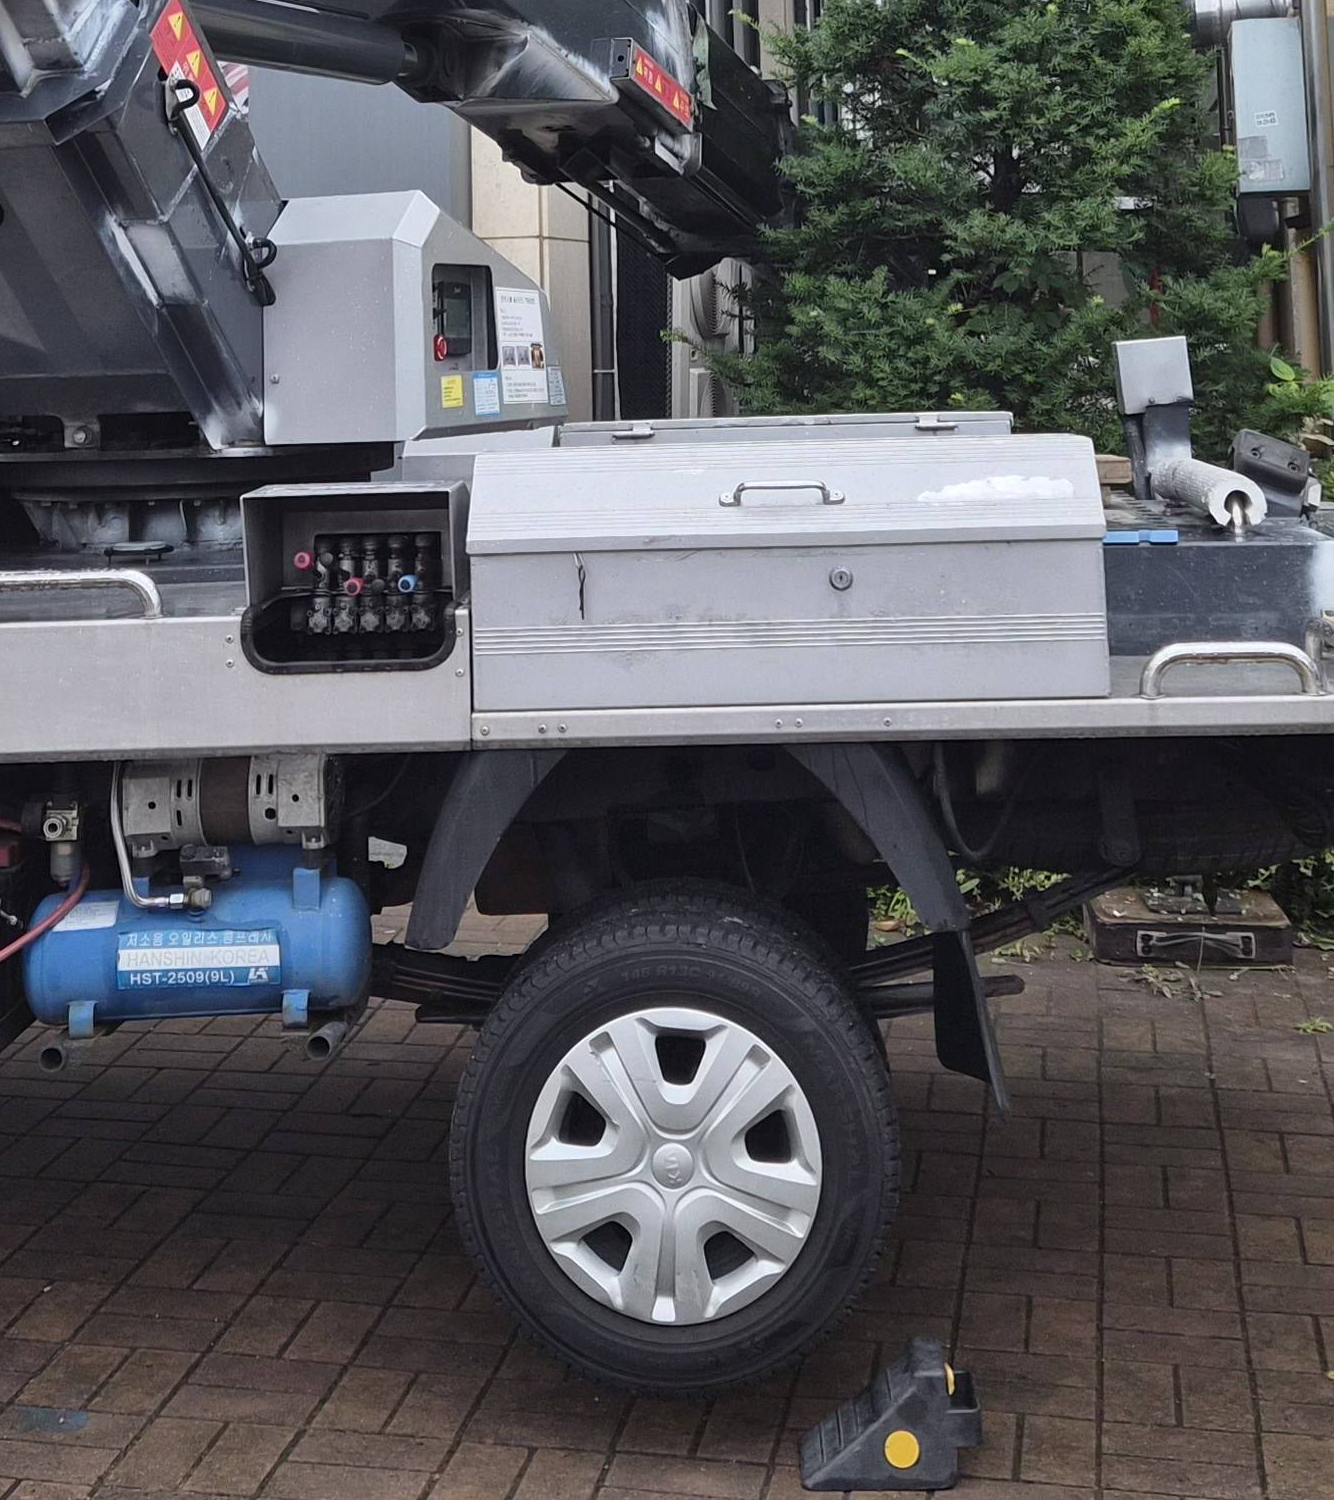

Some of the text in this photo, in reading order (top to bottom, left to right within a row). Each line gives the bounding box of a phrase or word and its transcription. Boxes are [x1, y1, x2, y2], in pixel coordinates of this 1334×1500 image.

[127, 948, 270, 967] HANSHIN KOREA
[130, 970, 235, 986] HST-2509(9L)
